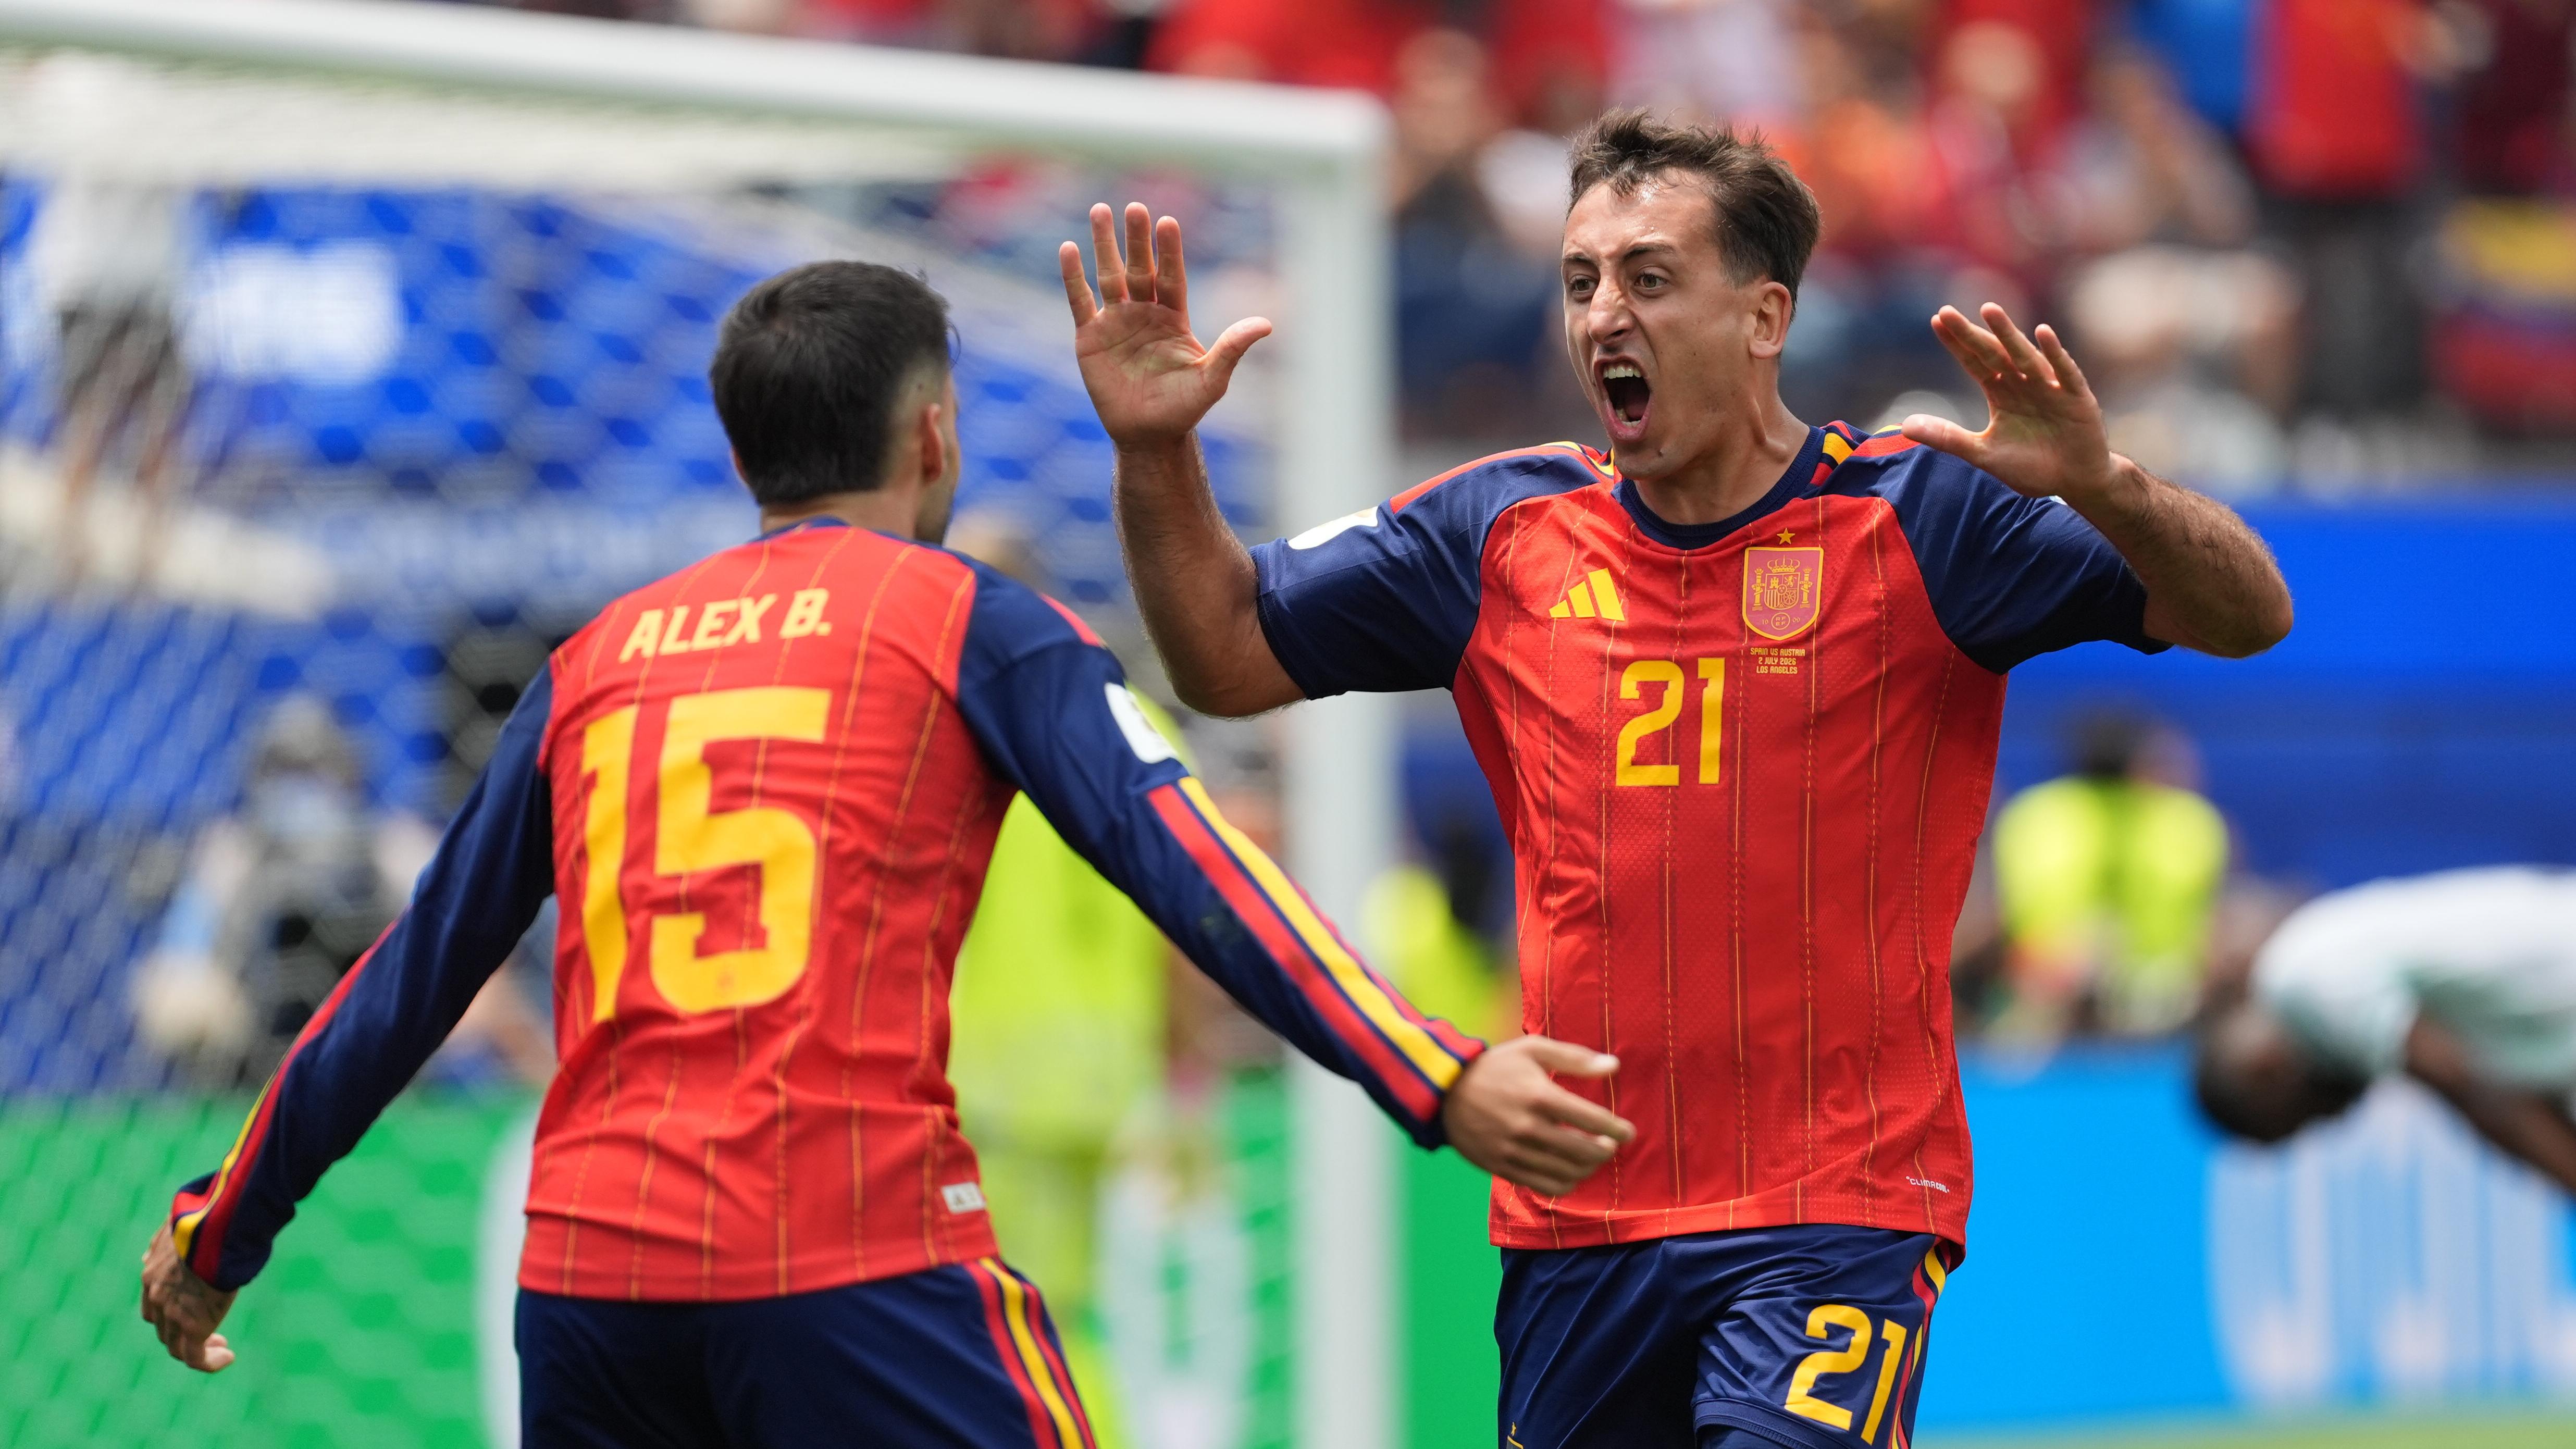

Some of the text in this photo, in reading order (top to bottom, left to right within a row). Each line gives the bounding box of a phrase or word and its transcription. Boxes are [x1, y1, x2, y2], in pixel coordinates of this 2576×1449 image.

[620, 588, 832, 663] ALEX B.
[1750, 647, 1768, 655] SPAIN
[1780, 648, 1805, 657] AUSTRIA
[1764, 657, 1778, 665] JULY
[1780, 657, 1797, 665] 2026
[1756, 665, 1798, 674] LOS ANGELES
[1615, 657, 1726, 787] 21
[581, 686, 832, 1025] 15
[1785, 1304, 1907, 1446] 21
